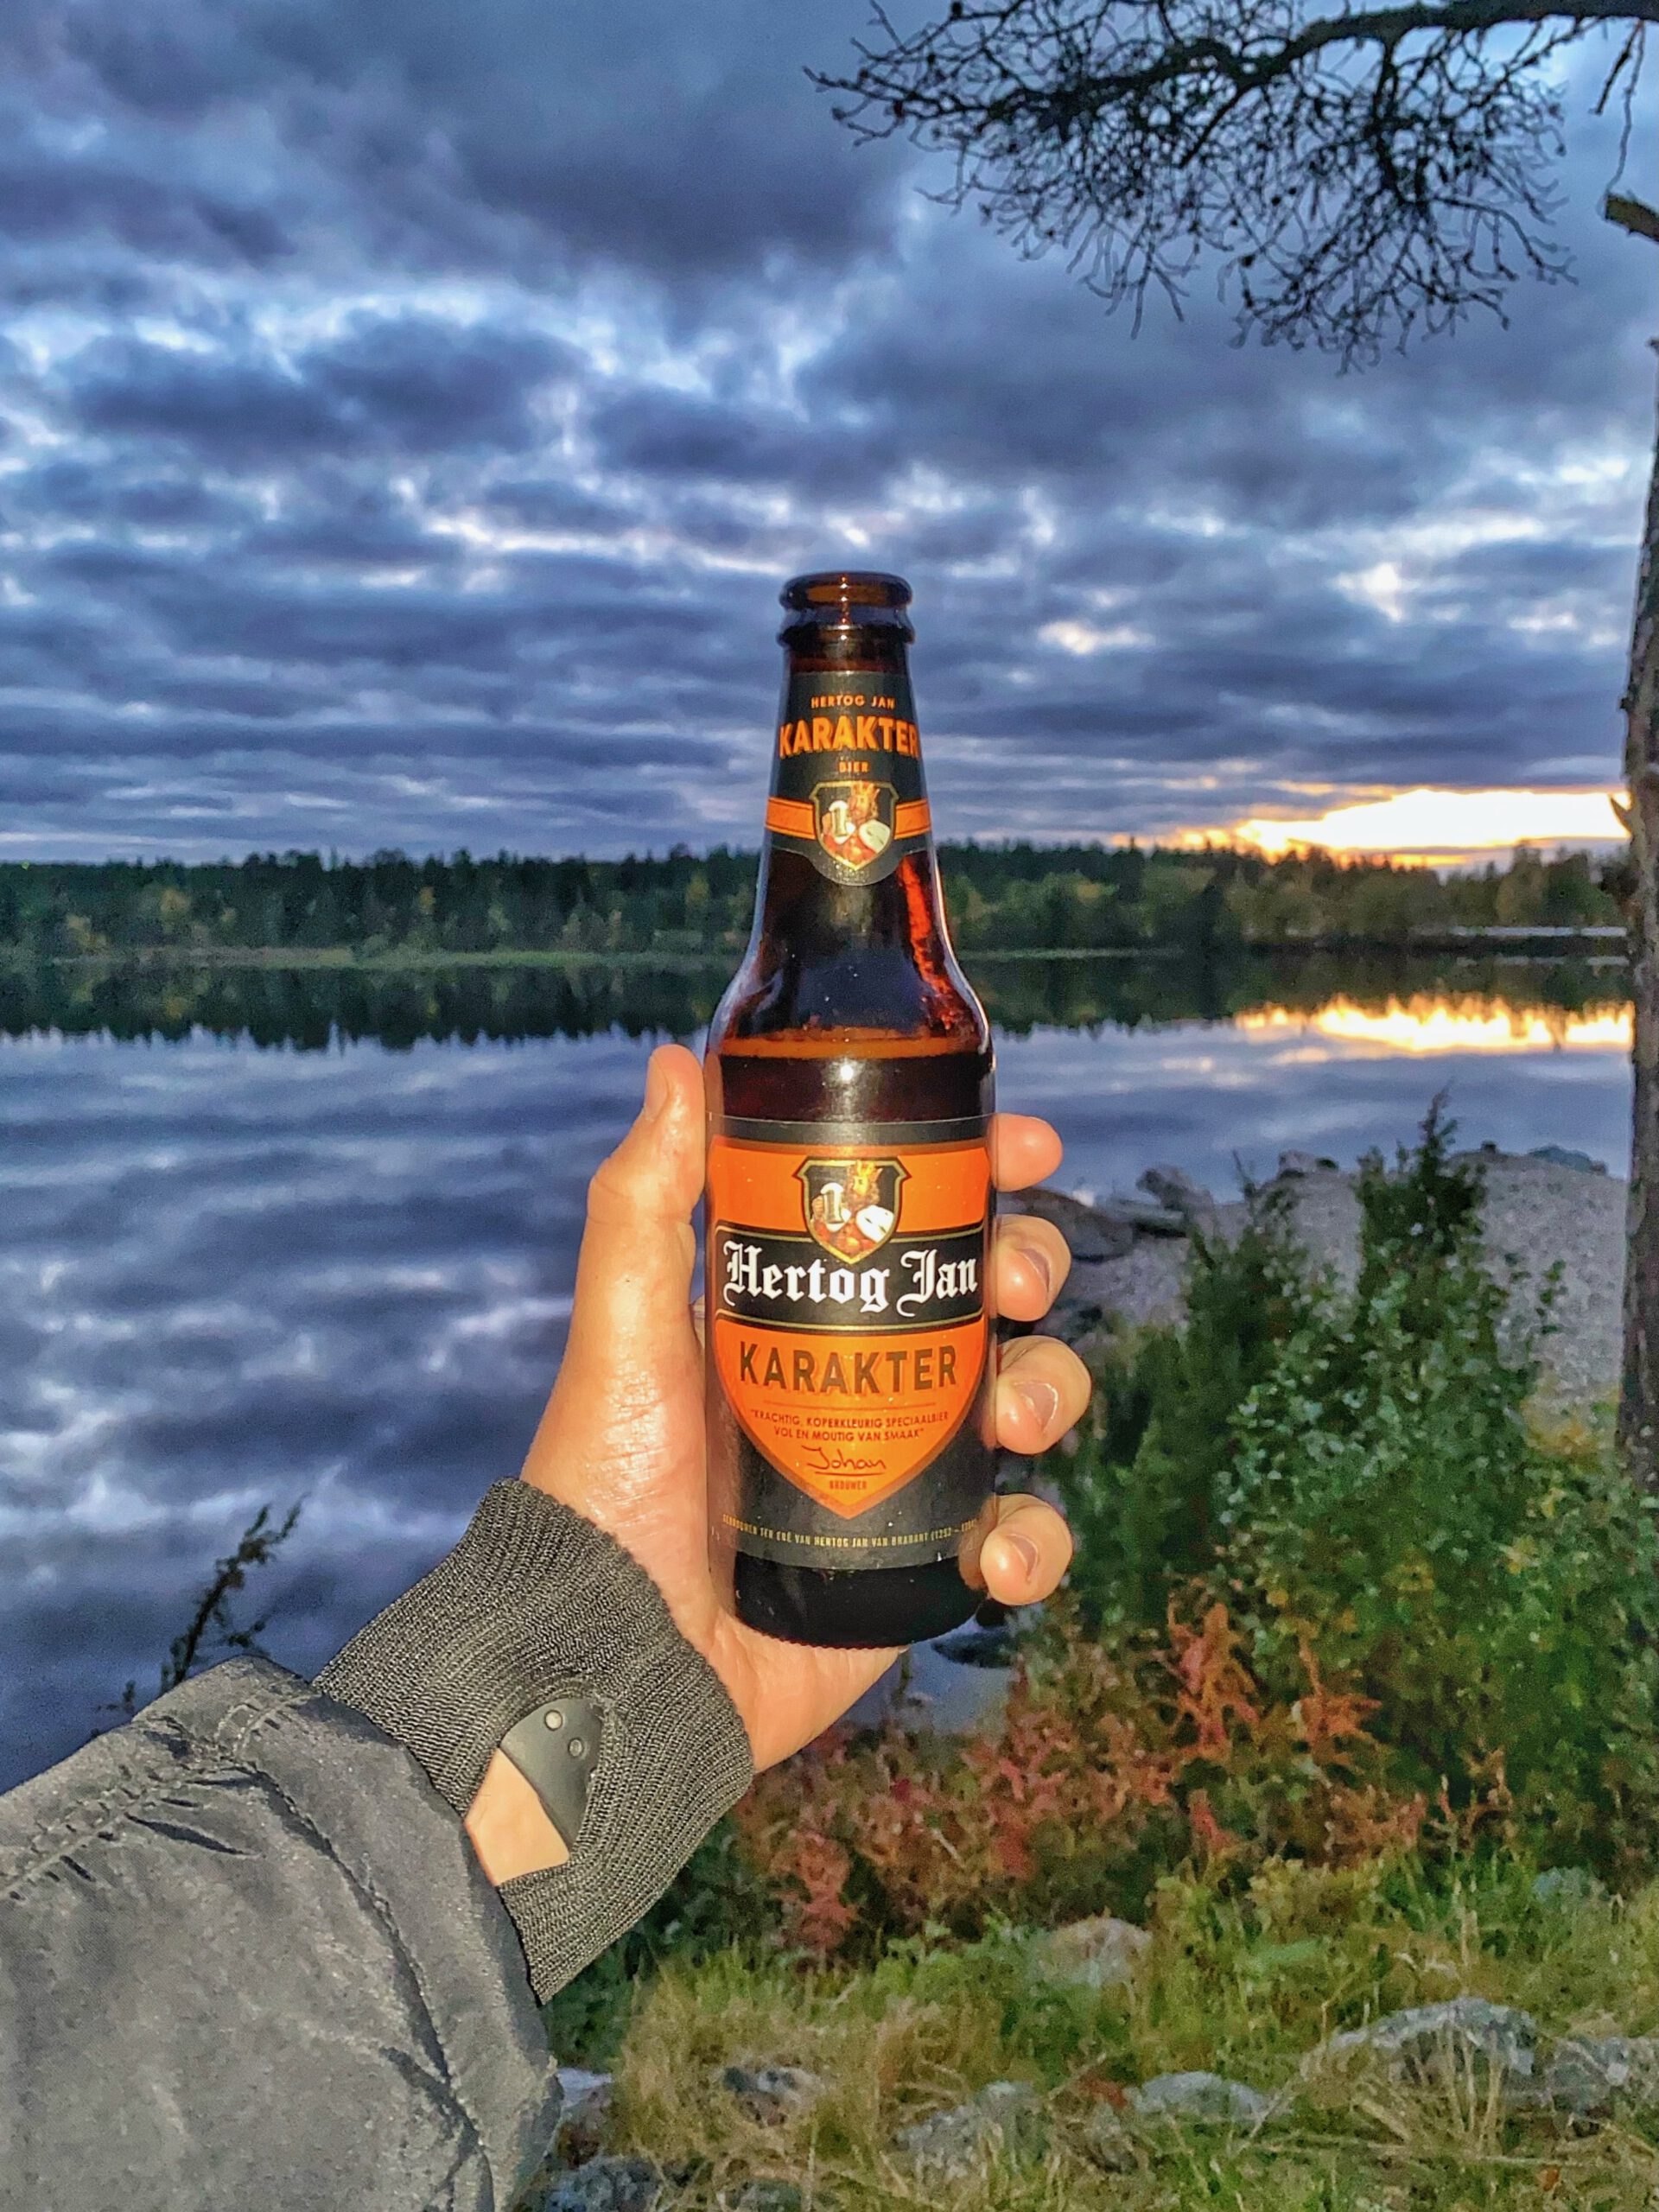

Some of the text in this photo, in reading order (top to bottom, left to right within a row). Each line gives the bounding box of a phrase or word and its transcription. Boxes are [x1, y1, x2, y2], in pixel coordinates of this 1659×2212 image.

[810, 695, 896, 709] HERTOG JAN
[779, 715, 920, 759] KARAKTER
[838, 761, 869, 773] BIER
[723, 1240, 978, 1317] Hertog Jan
[740, 1341, 957, 1397] KARAKTER
[806, 1416, 882, 1428] KOPERKLEURIG
[774, 1426, 793, 1438] VOL
[796, 1429, 809, 1440] EN
[812, 1431, 855, 1441] MOUTIG
[857, 1432, 881, 1441] VAN
[801, 1446, 887, 1471] Johan
[814, 1535, 849, 1548] HERTOG
